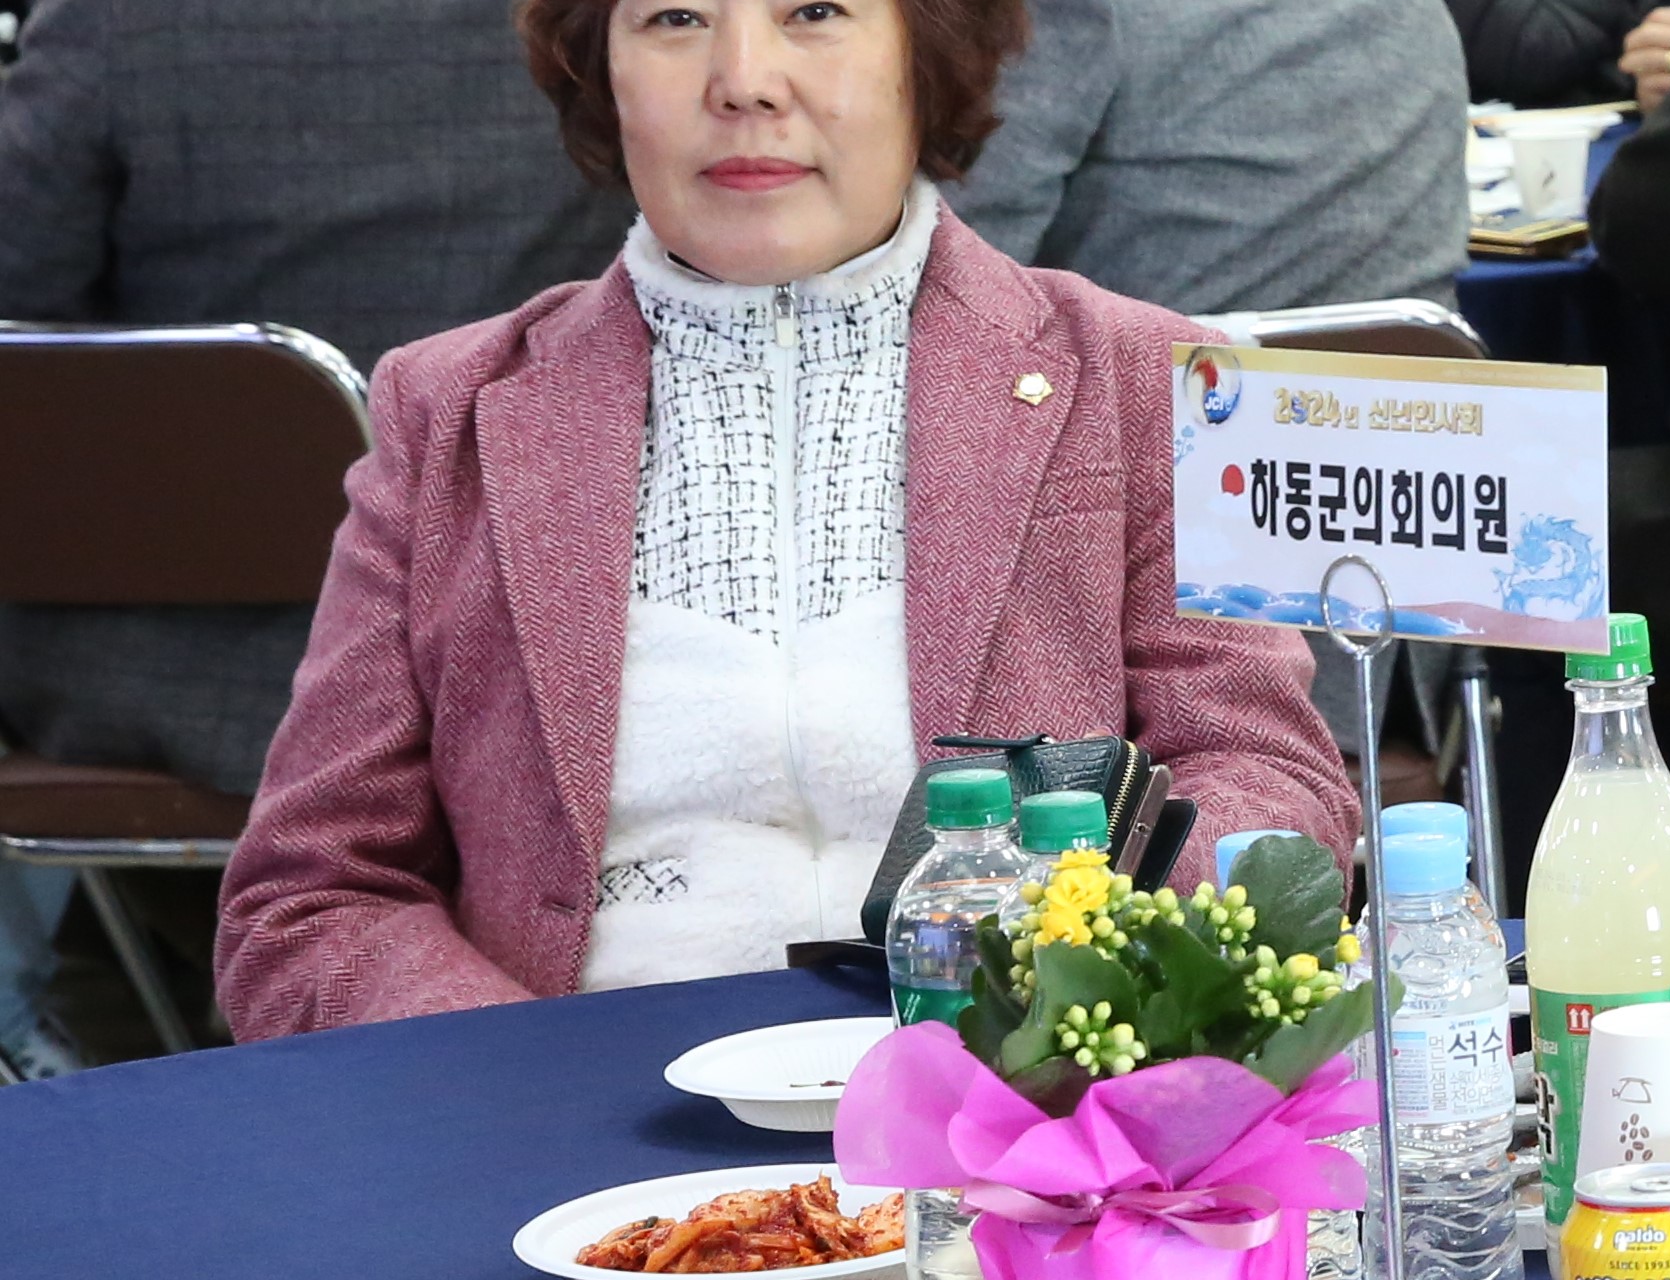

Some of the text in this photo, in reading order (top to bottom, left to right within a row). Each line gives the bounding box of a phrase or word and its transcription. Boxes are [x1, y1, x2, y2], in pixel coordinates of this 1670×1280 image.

[1368, 398, 1484, 436] 신년인사회
[1250, 457, 1509, 554] 하동군의회의원
[1447, 1027, 1504, 1067] 석수
[1428, 1035, 1449, 1111] 먹는샘물
[1613, 1225, 1666, 1249] paldo
